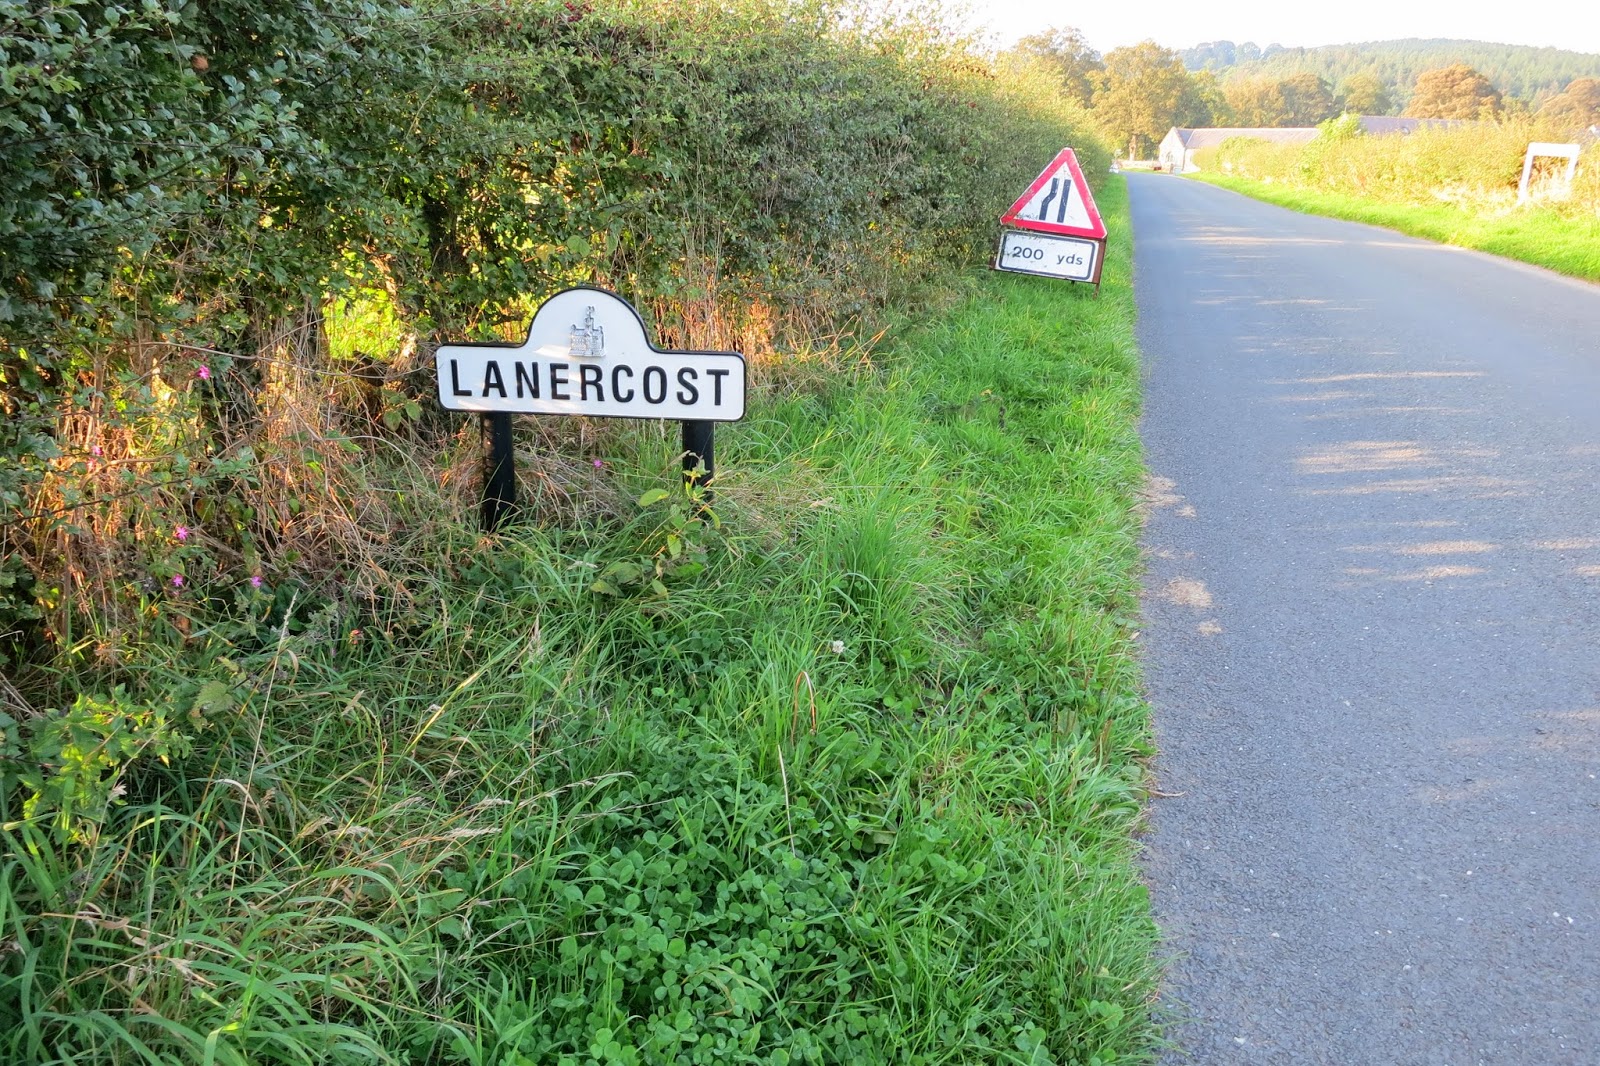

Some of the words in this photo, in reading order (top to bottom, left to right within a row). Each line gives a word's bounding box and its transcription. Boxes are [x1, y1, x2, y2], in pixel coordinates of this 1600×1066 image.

[1012, 246, 1044, 260] 200
[1056, 253, 1083, 266] yds
[450, 358, 730, 406] LANERCOST
